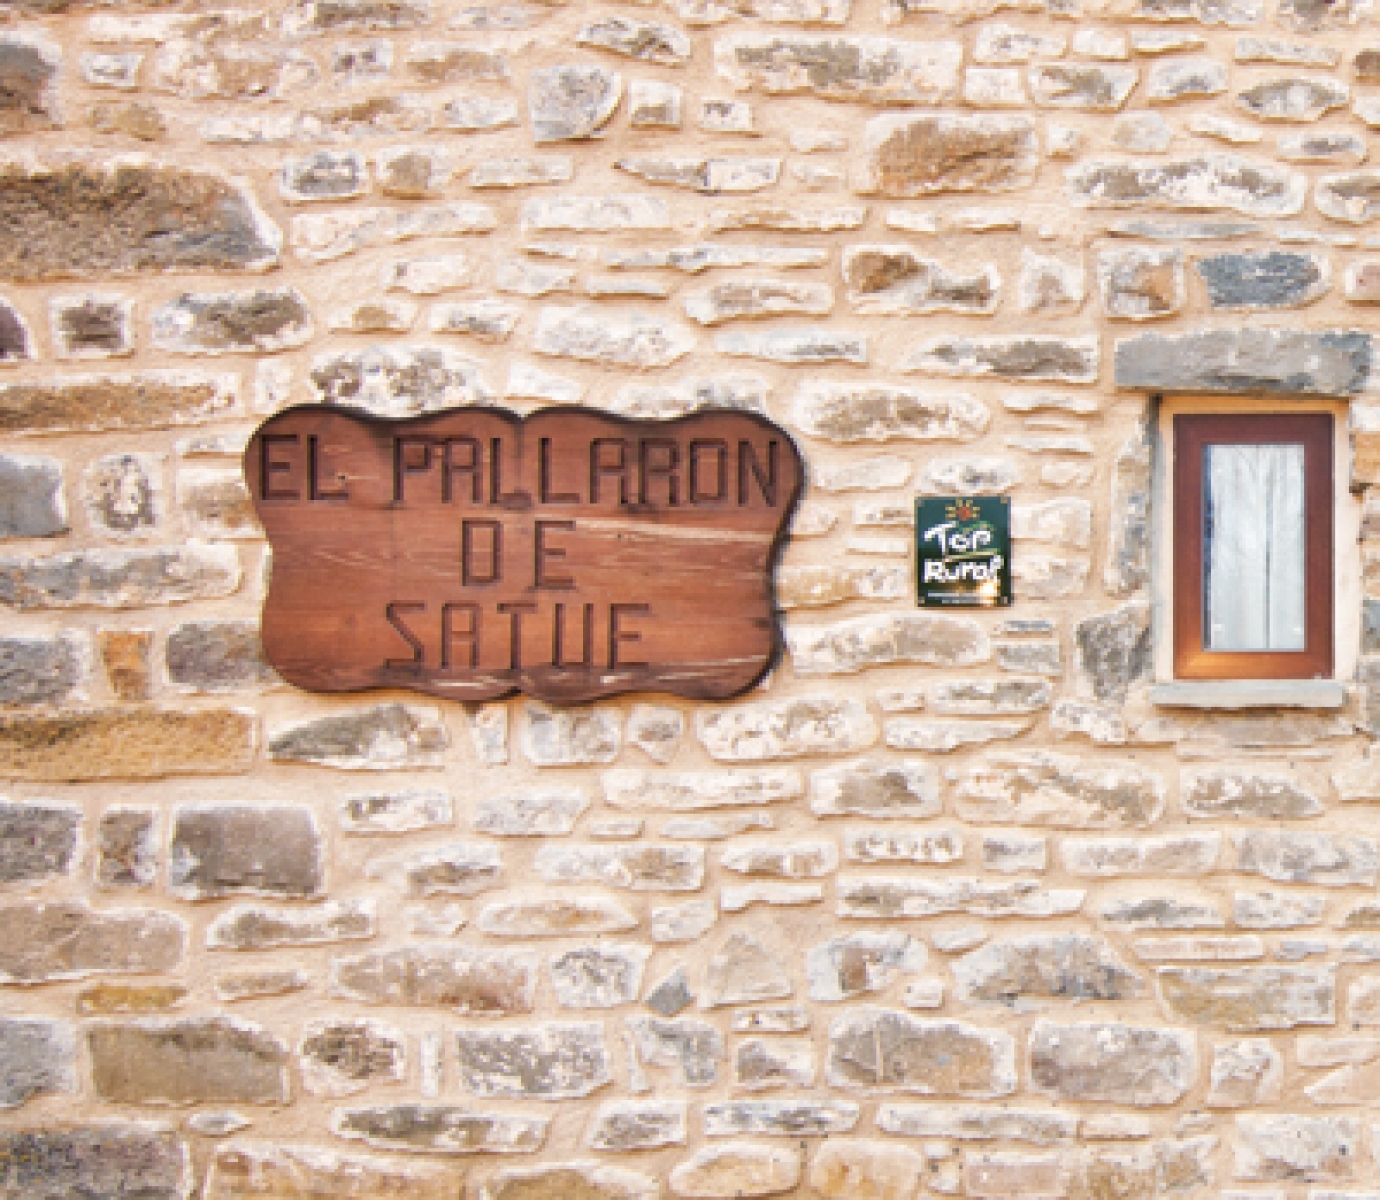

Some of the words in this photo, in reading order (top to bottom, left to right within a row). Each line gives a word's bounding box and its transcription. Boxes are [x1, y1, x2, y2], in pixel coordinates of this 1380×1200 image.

[260, 434, 350, 501] EL
[393, 434, 778, 507] PALLARON
[461, 519, 577, 590] DE
[923, 520, 993, 555] Top
[923, 555, 1004, 584] Rural
[383, 602, 651, 671] SATUE
